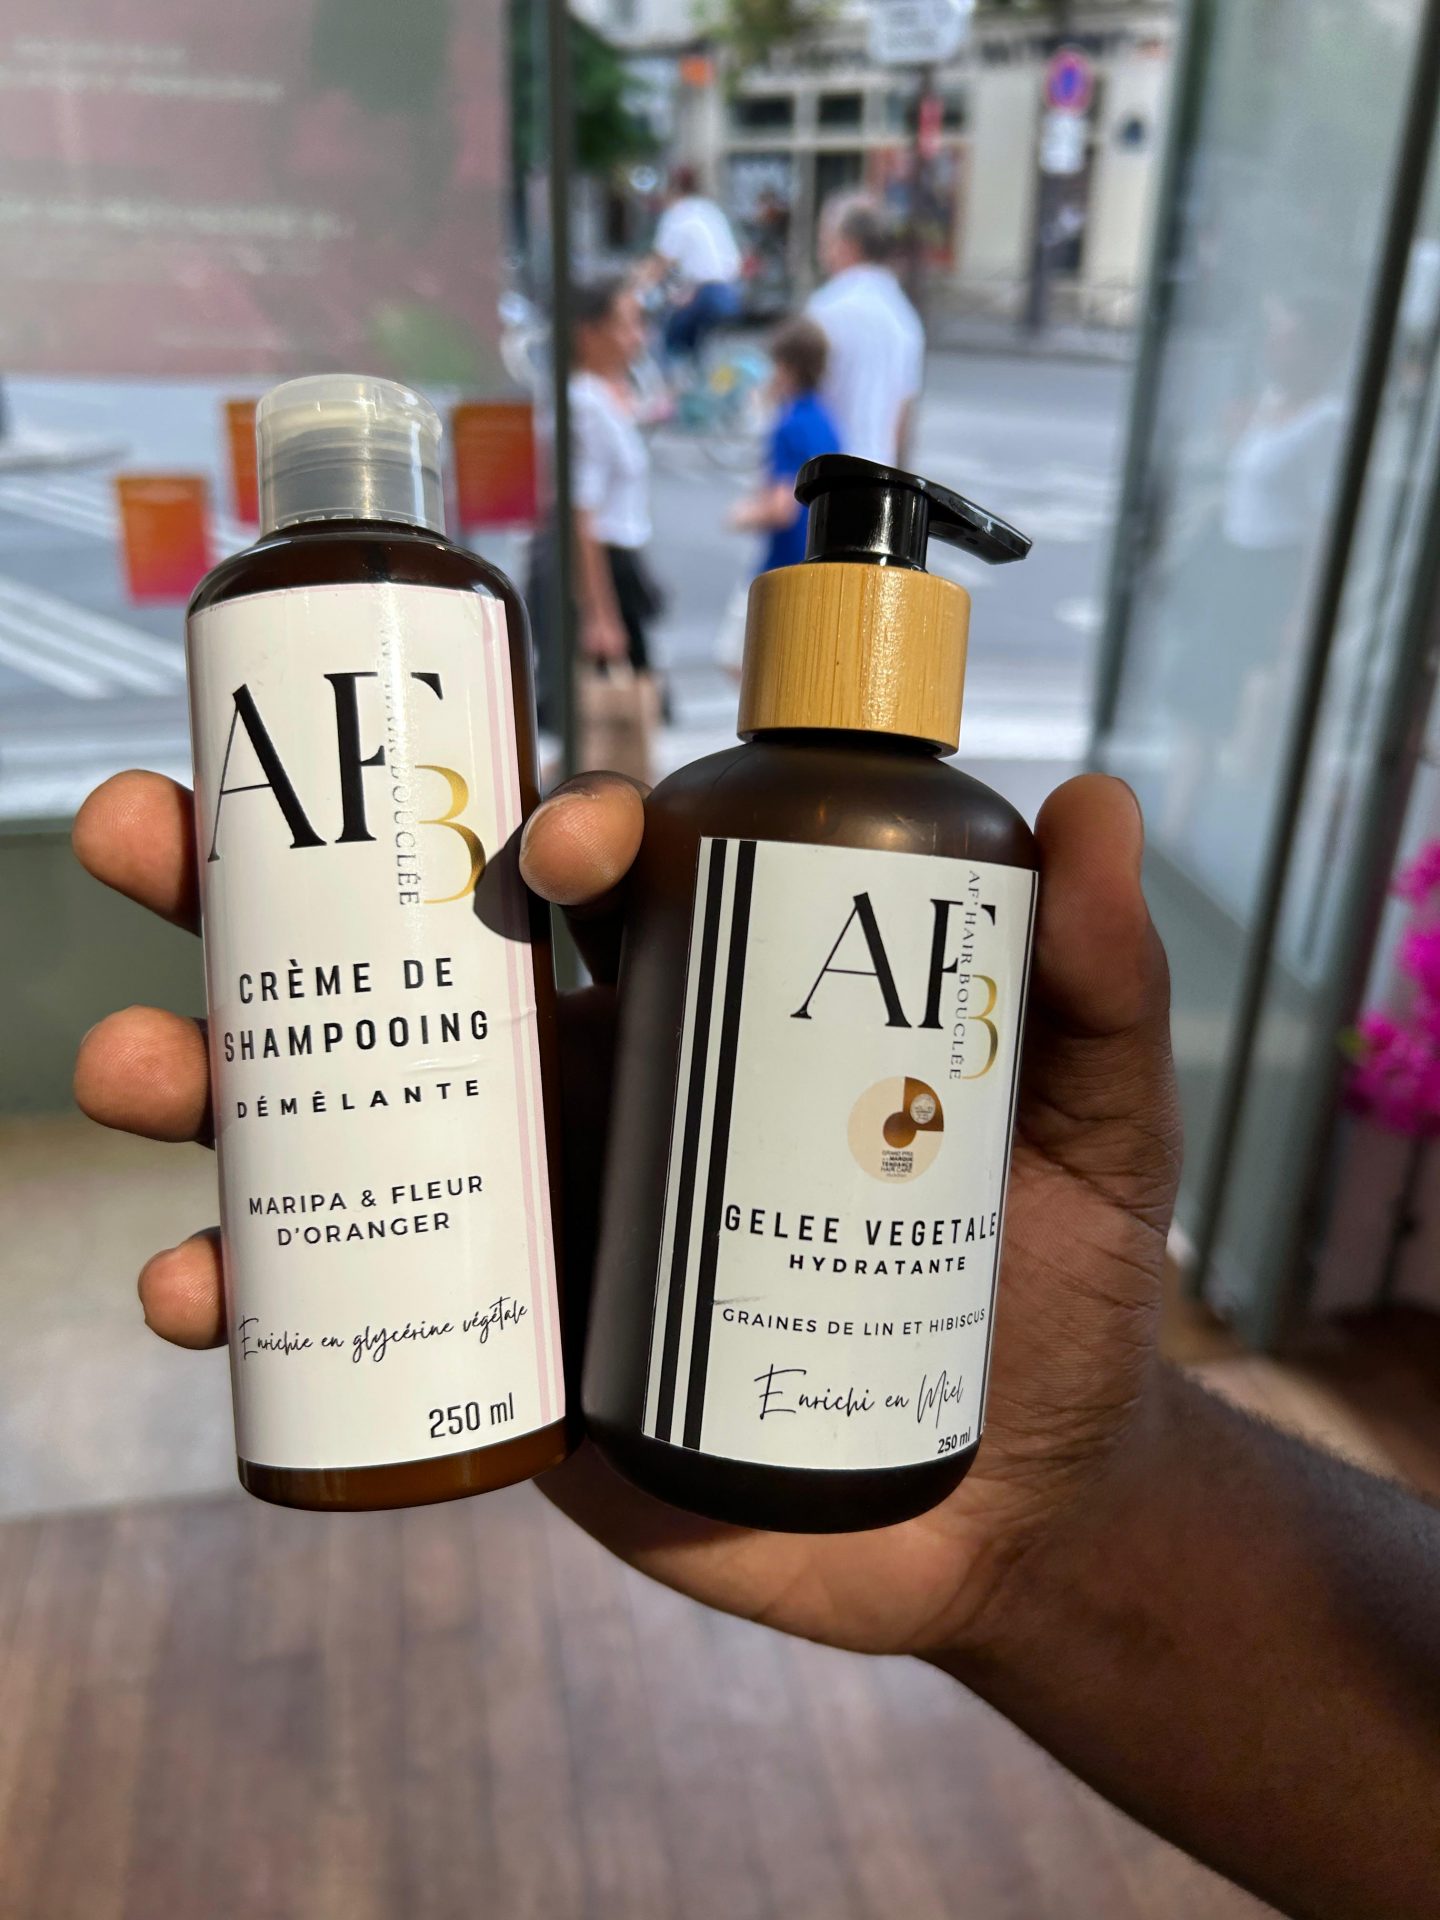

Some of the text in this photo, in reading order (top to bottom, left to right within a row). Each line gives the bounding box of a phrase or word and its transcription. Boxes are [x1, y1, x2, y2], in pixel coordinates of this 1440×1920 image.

[960, 911, 977, 964] HAIR
[239, 957, 454, 1005] CRÈME DE
[224, 1010, 489, 1063] SHAMPOOING
[949, 973, 971, 1080] BOUCLÉE
[237, 1079, 480, 1119] DÉMÊLANTE
[249, 1175, 483, 1216] MARIPA & FLEUR
[277, 1212, 450, 1246] D'ORANGER
[724, 1204, 998, 1247] GELEE VEGETALE
[789, 1254, 967, 1276] HYDRATANTE
[238, 1296, 528, 1364] Enrichie en glycérine végétale
[722, 1307, 986, 1337] GRAINES DE LIN ET HIBISCUS
[428, 1391, 515, 1439] 250 ml
[754, 1363, 965, 1430] Enrichi en Miel
[937, 1426, 971, 1455] 250 ml
